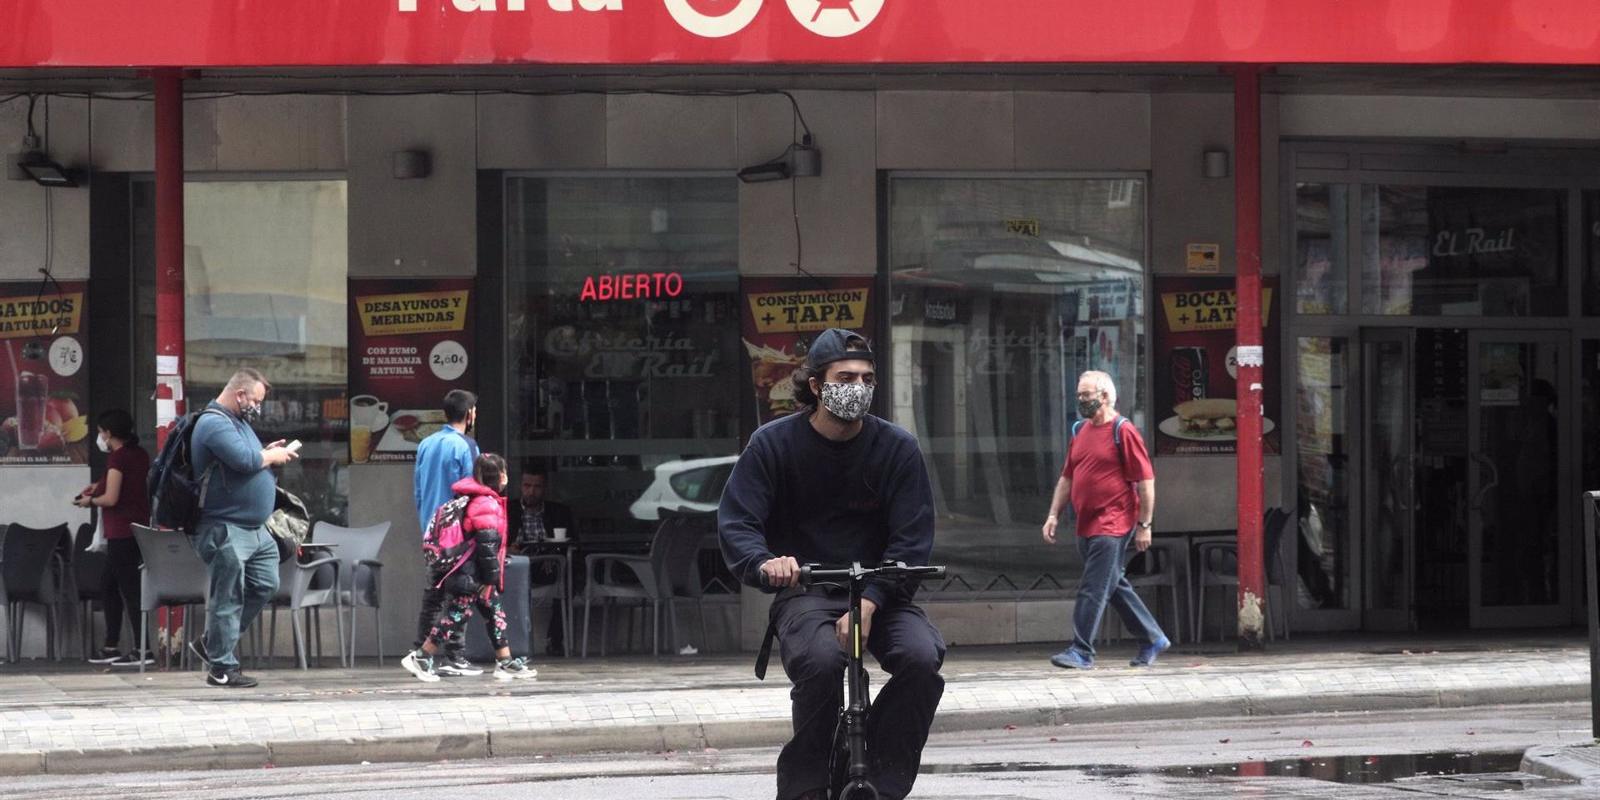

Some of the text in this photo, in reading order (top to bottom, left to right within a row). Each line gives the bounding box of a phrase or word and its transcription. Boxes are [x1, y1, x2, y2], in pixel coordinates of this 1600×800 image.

[1433, 228, 1515, 257] El Rail
[580, 272, 683, 301] ABIERTO
[364, 297, 462, 313] DESAYUNOS Y
[1175, 291, 1237, 308] BOCA
[0, 298, 74, 318] ATIDOS
[783, 304, 853, 324] TAPA
[1195, 307, 1237, 323] LAT
[371, 311, 455, 327] MERIENDAS
[388, 346, 418, 354] ZUMO
[363, 356, 422, 365] DE NARANJA
[637, 350, 719, 378] Rail
[370, 366, 415, 375] NATURAL
